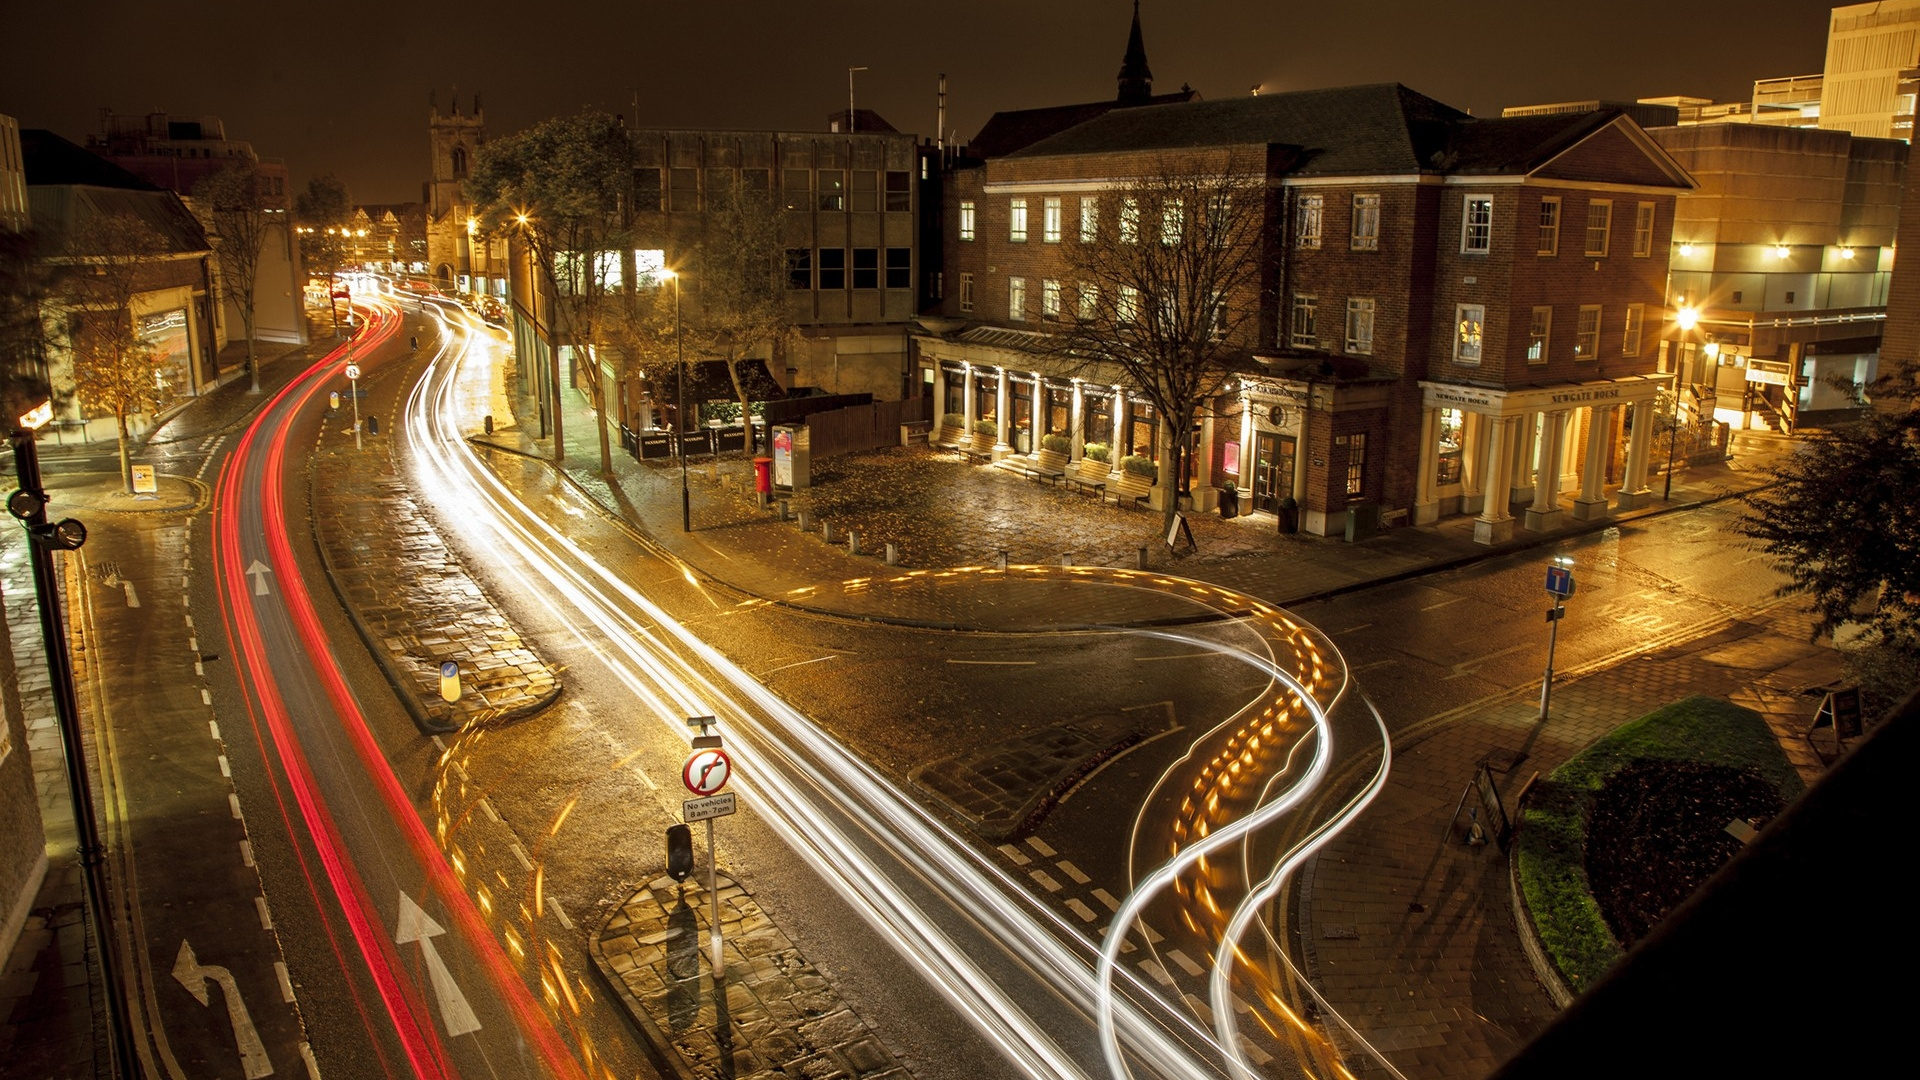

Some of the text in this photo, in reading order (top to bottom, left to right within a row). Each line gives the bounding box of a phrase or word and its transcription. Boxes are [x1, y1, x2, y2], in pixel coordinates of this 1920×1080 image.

[1435, 393, 1489, 405] NEWGATE HOUSE
[1552, 389, 1619, 403] NEWGATE HOUSE
[701, 798, 731, 807] vehicles
